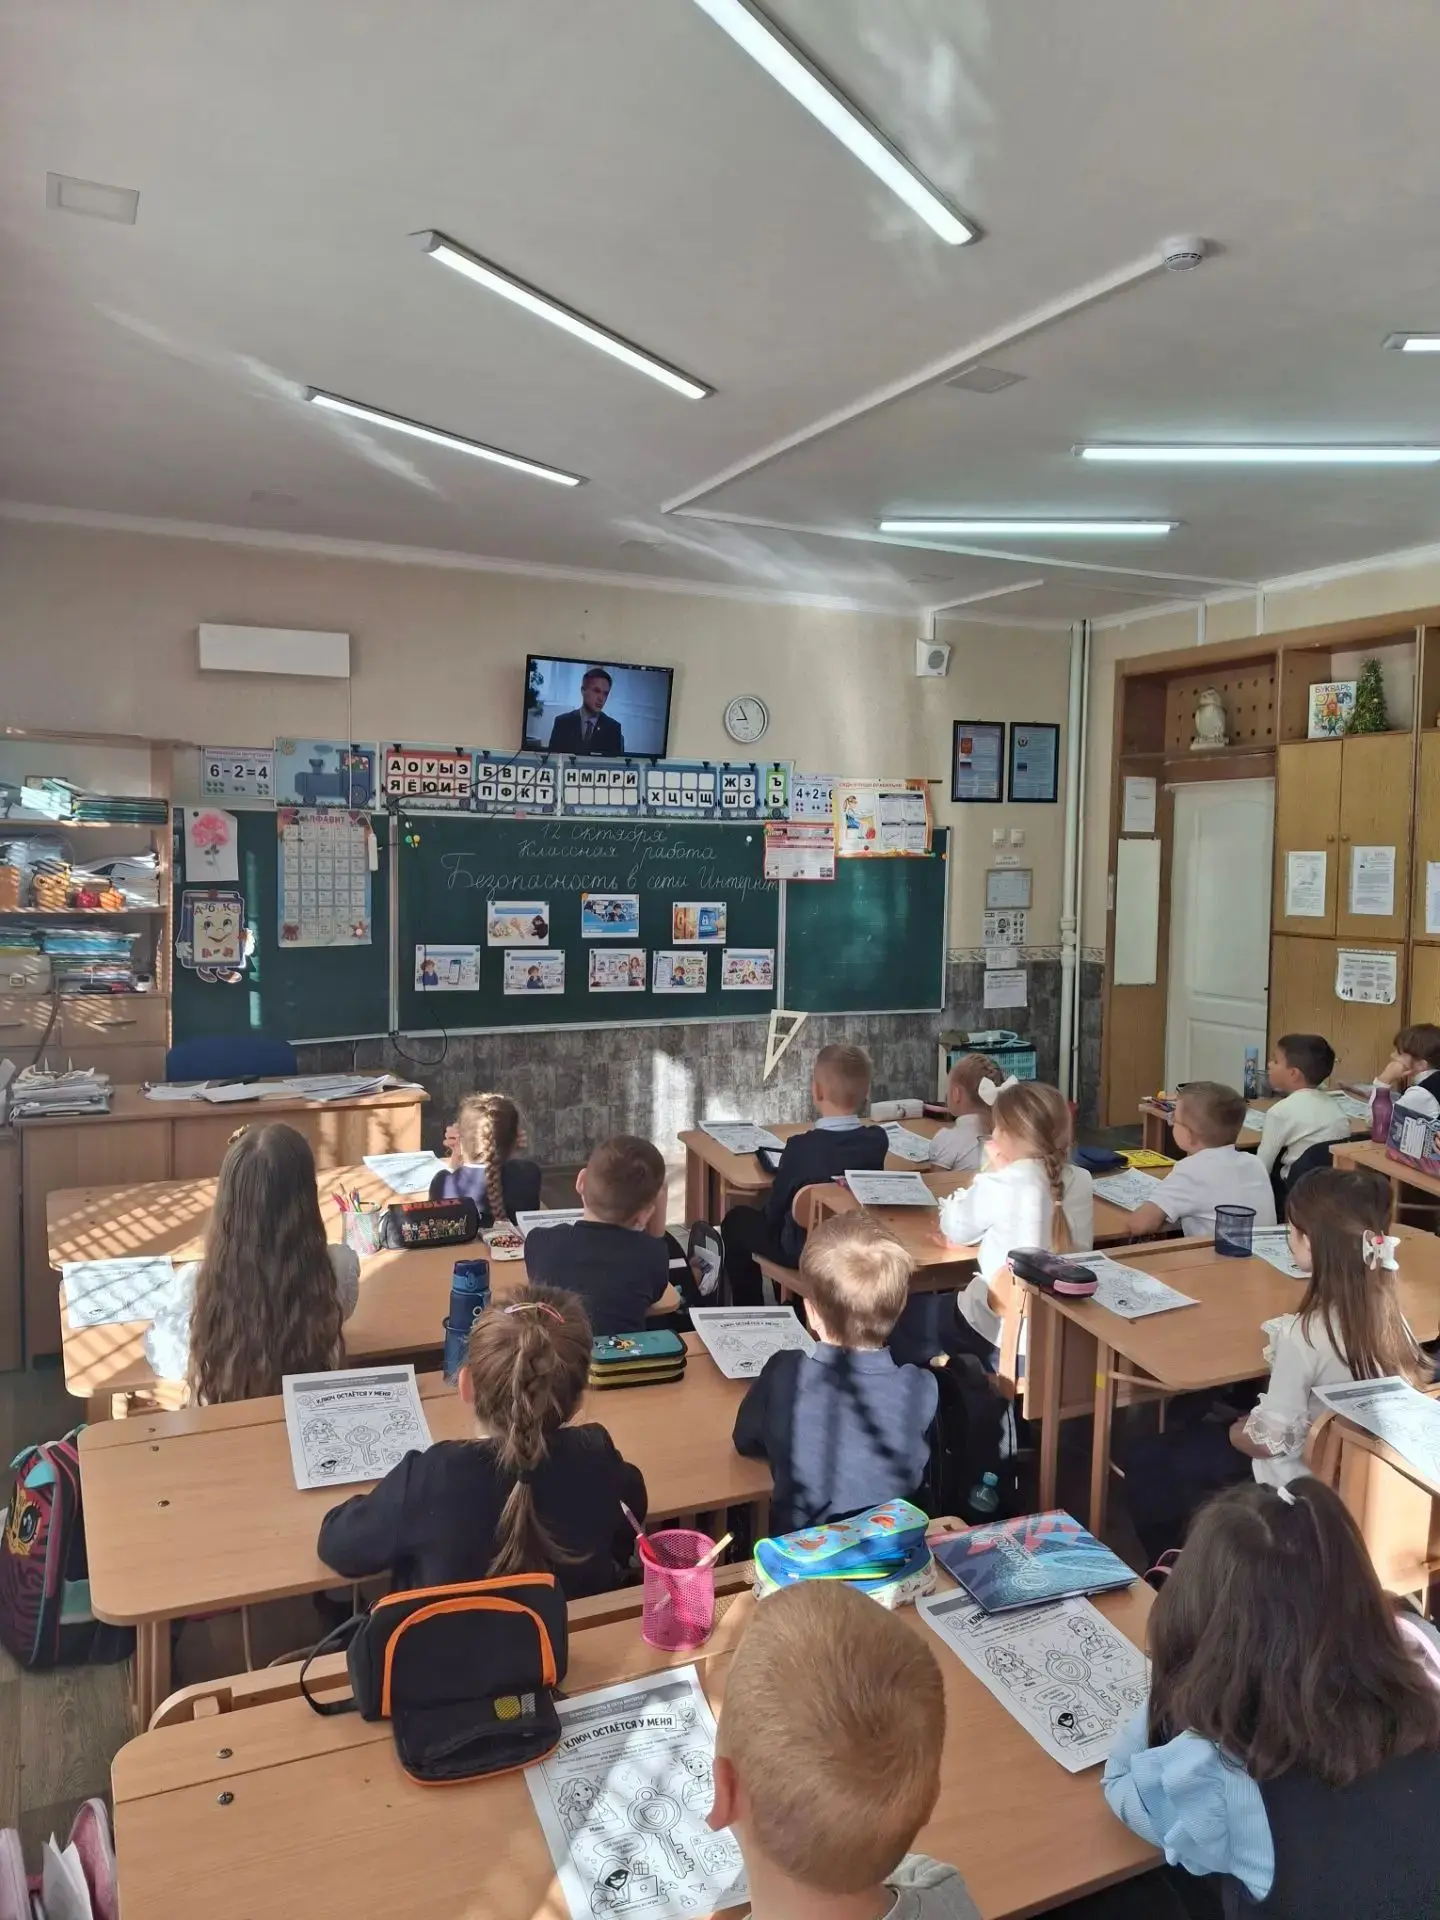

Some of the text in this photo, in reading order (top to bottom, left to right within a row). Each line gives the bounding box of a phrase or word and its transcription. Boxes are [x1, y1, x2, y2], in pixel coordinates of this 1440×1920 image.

[541, 822, 561, 840] 12
[563, 1717, 673, 1749] КЛЮЧ ОСТАЁТСЯ У МЕНЯ
